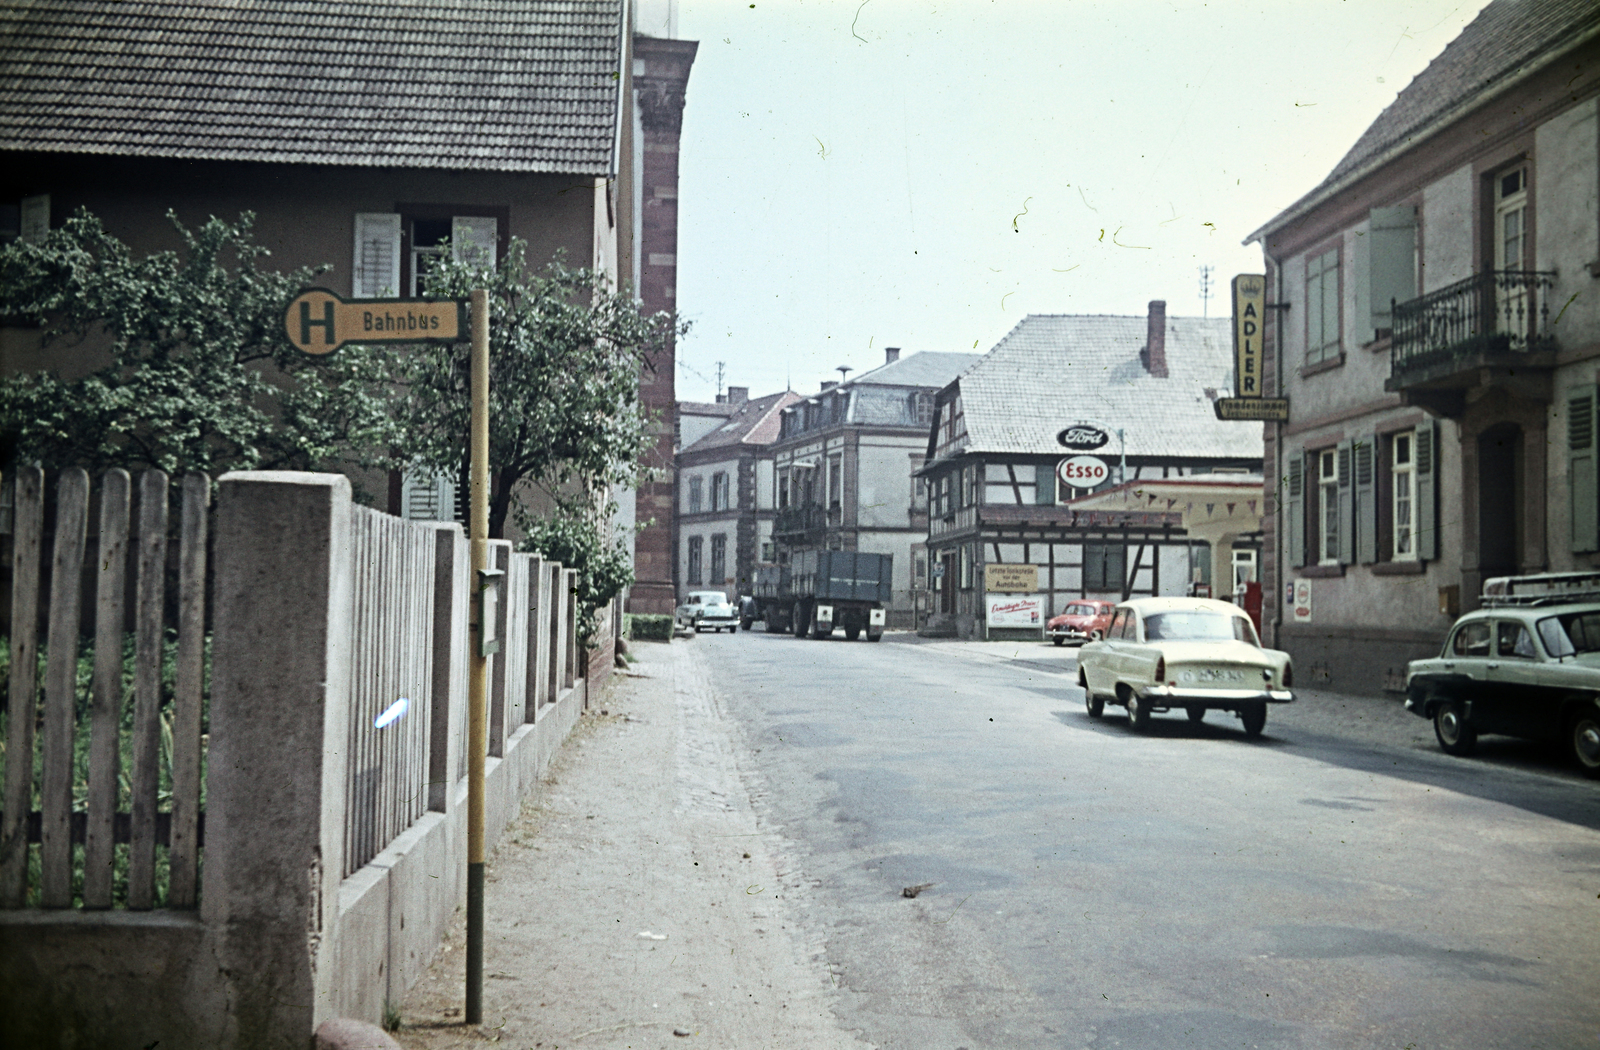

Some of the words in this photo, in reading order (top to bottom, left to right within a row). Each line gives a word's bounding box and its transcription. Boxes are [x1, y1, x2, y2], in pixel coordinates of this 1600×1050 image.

[301, 301, 335, 344] H
[363, 311, 439, 331] Bahnbus
[1244, 303, 1257, 392] ADLER
[1065, 429, 1103, 443] Ford
[1007, 567, 1034, 575] Tankstelle
